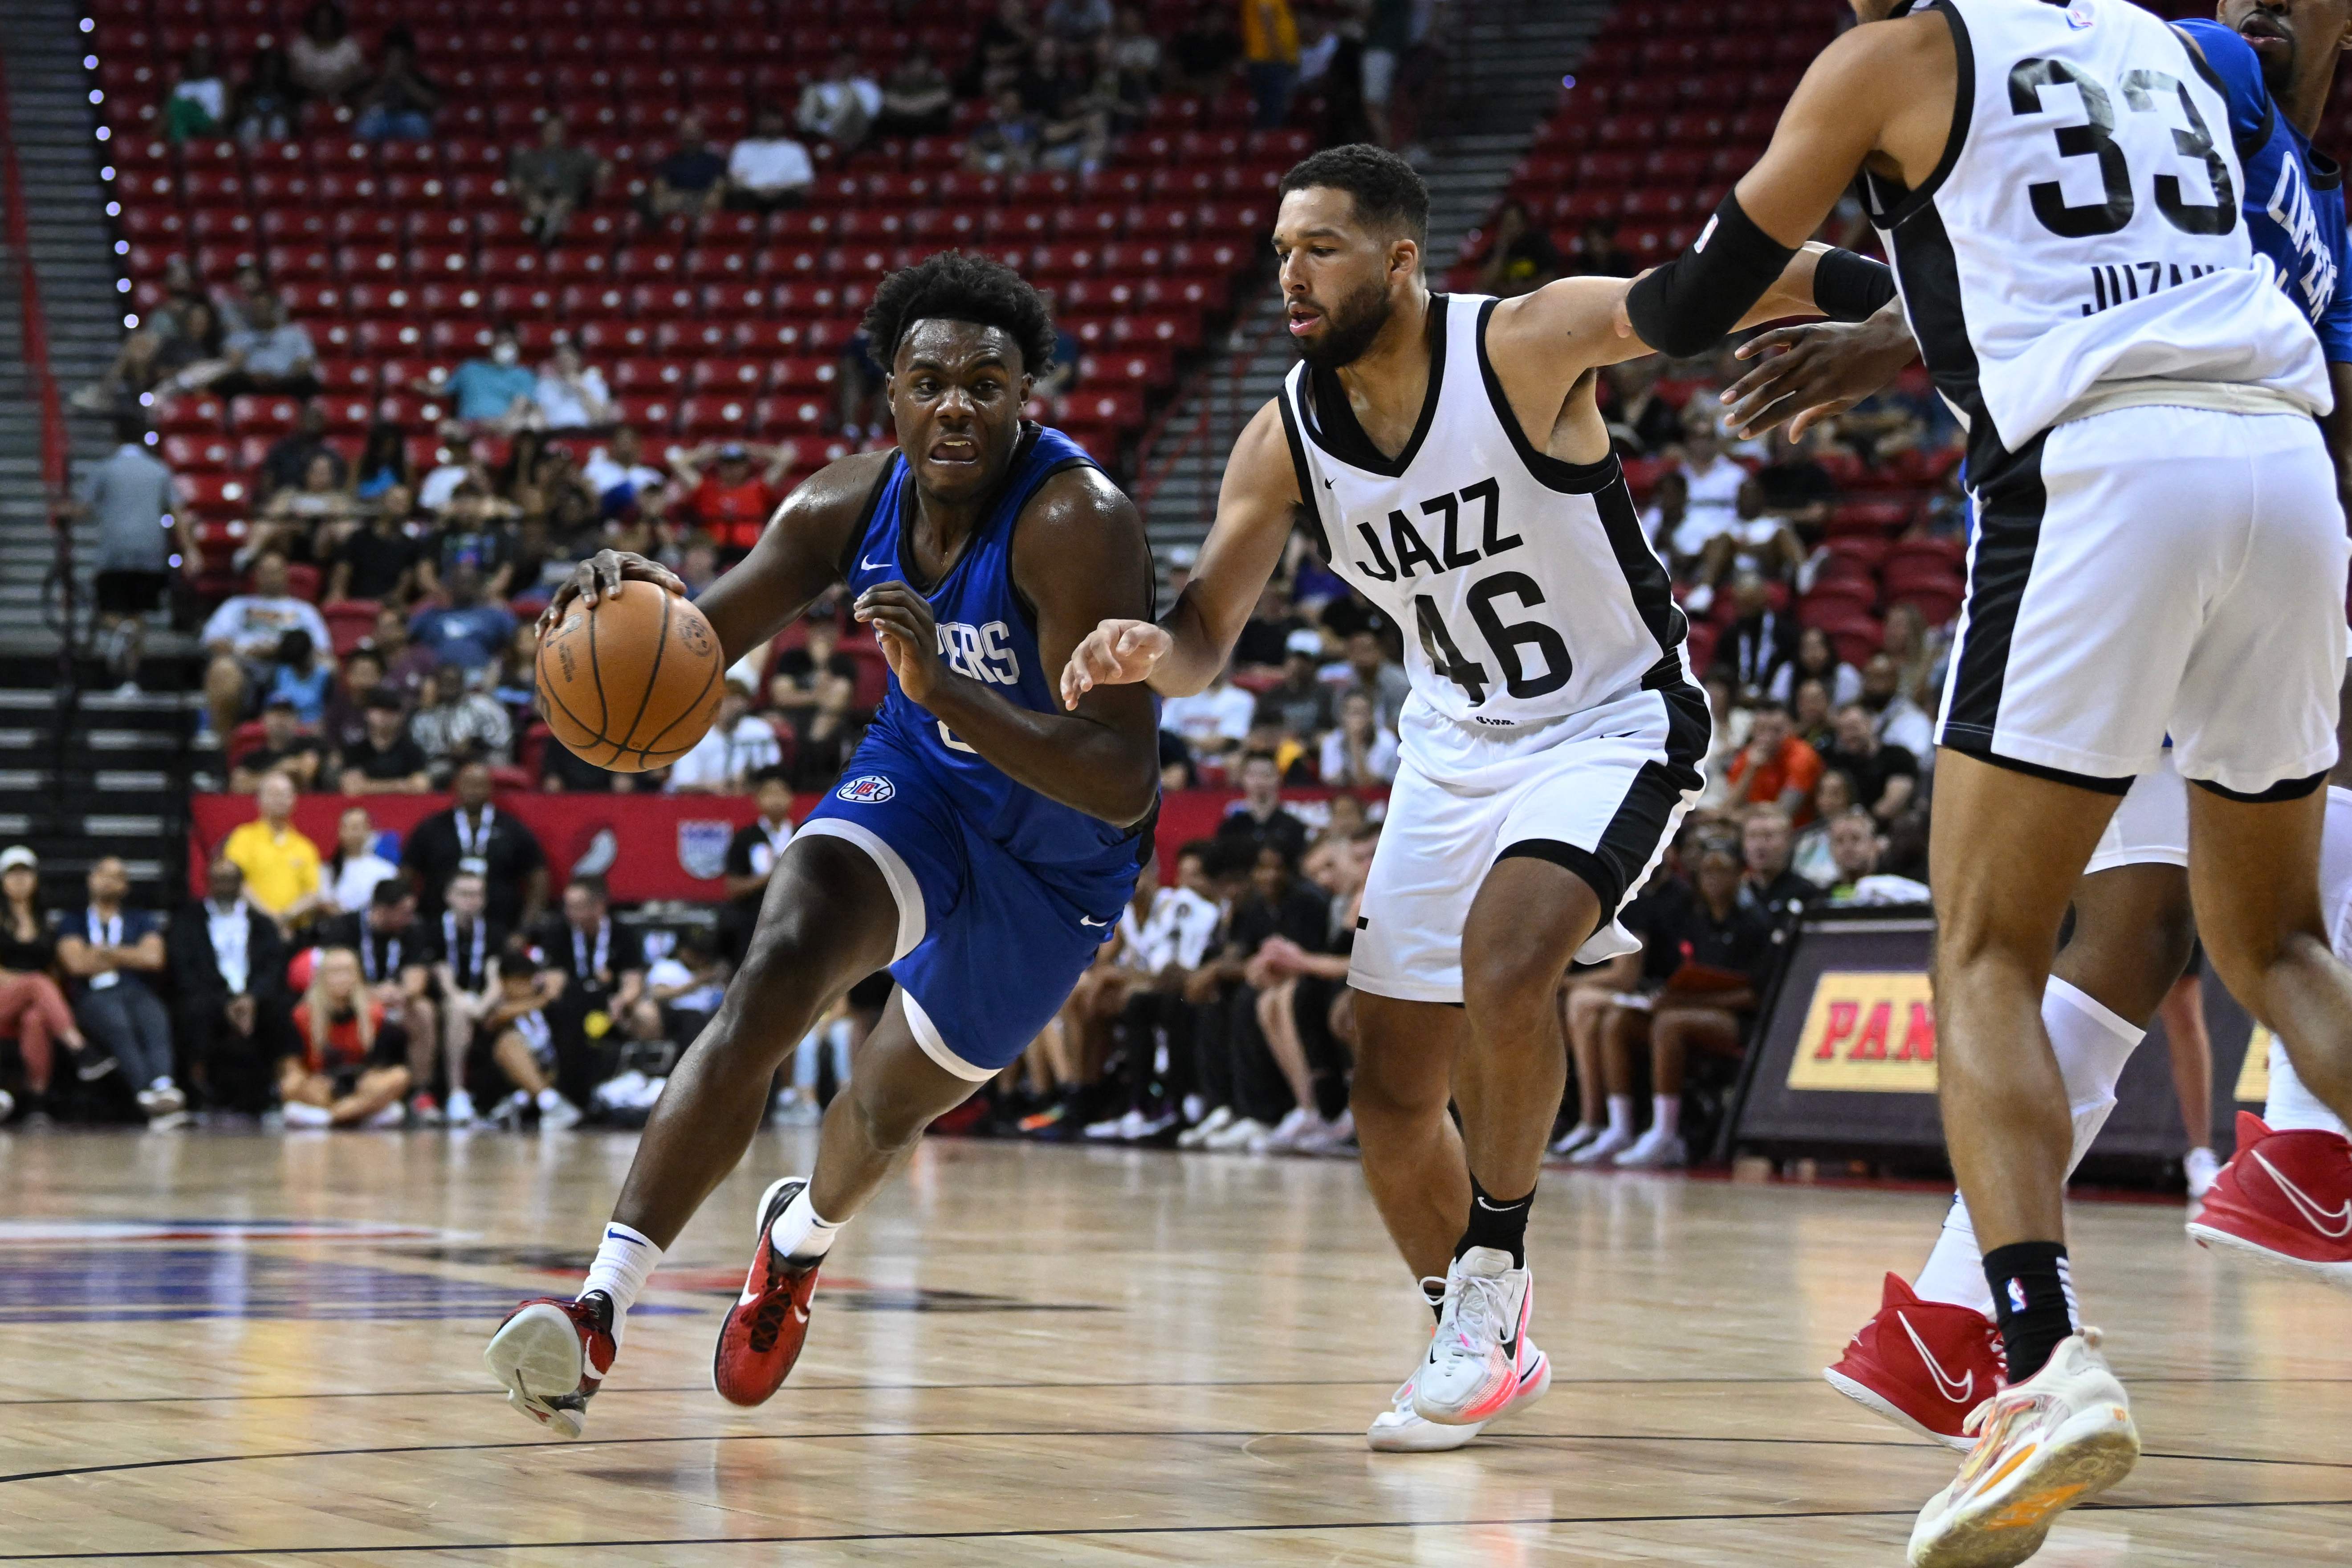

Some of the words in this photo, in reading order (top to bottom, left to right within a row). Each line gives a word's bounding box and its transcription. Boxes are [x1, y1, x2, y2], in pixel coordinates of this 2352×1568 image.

[2007, 58, 2237, 237] 33
[1355, 477, 1523, 582] JAZZ
[1415, 571, 1573, 708] 46
